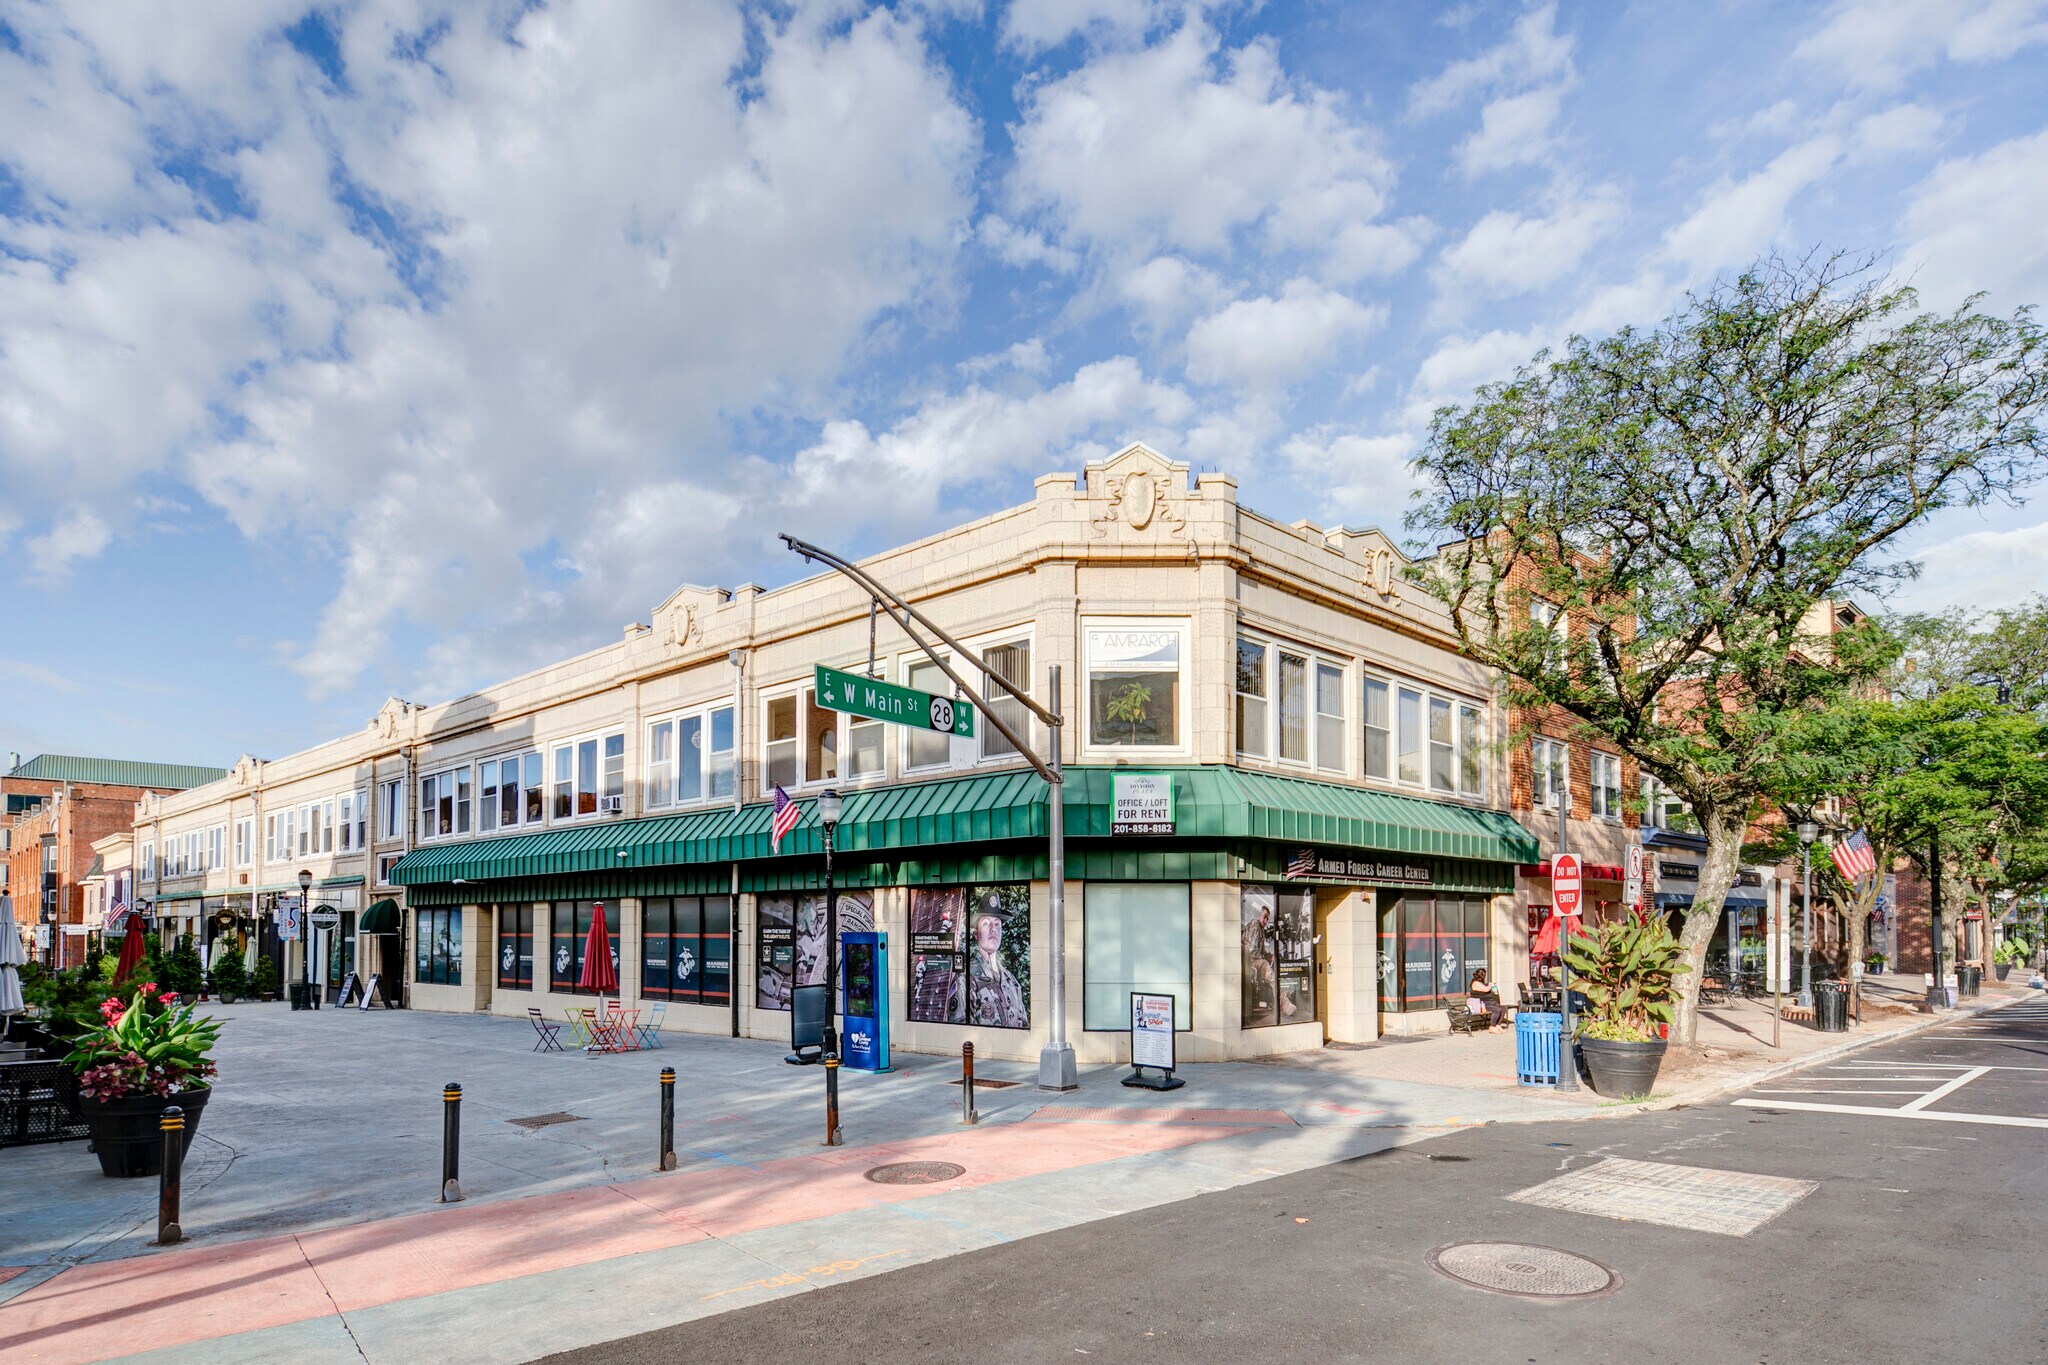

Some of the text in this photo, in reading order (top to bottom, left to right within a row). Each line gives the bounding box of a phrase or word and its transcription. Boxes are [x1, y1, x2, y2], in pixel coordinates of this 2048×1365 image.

[1104, 634, 1177, 647] AMRARCH
[825, 672, 831, 687] E
[843, 682, 918, 715] W Main St
[933, 704, 950, 725] 28
[959, 705, 967, 718] W
[1118, 799, 1143, 807] OFFICE
[1151, 799, 1168, 807] LOFT
[1118, 809, 1168, 819] FOR RENT
[1114, 824, 1173, 834] 201-858-8182
[1557, 867, 1577, 876] DO NOT
[1559, 893, 1575, 903] ENTER
[845, 905, 863, 918] SPECIAL
